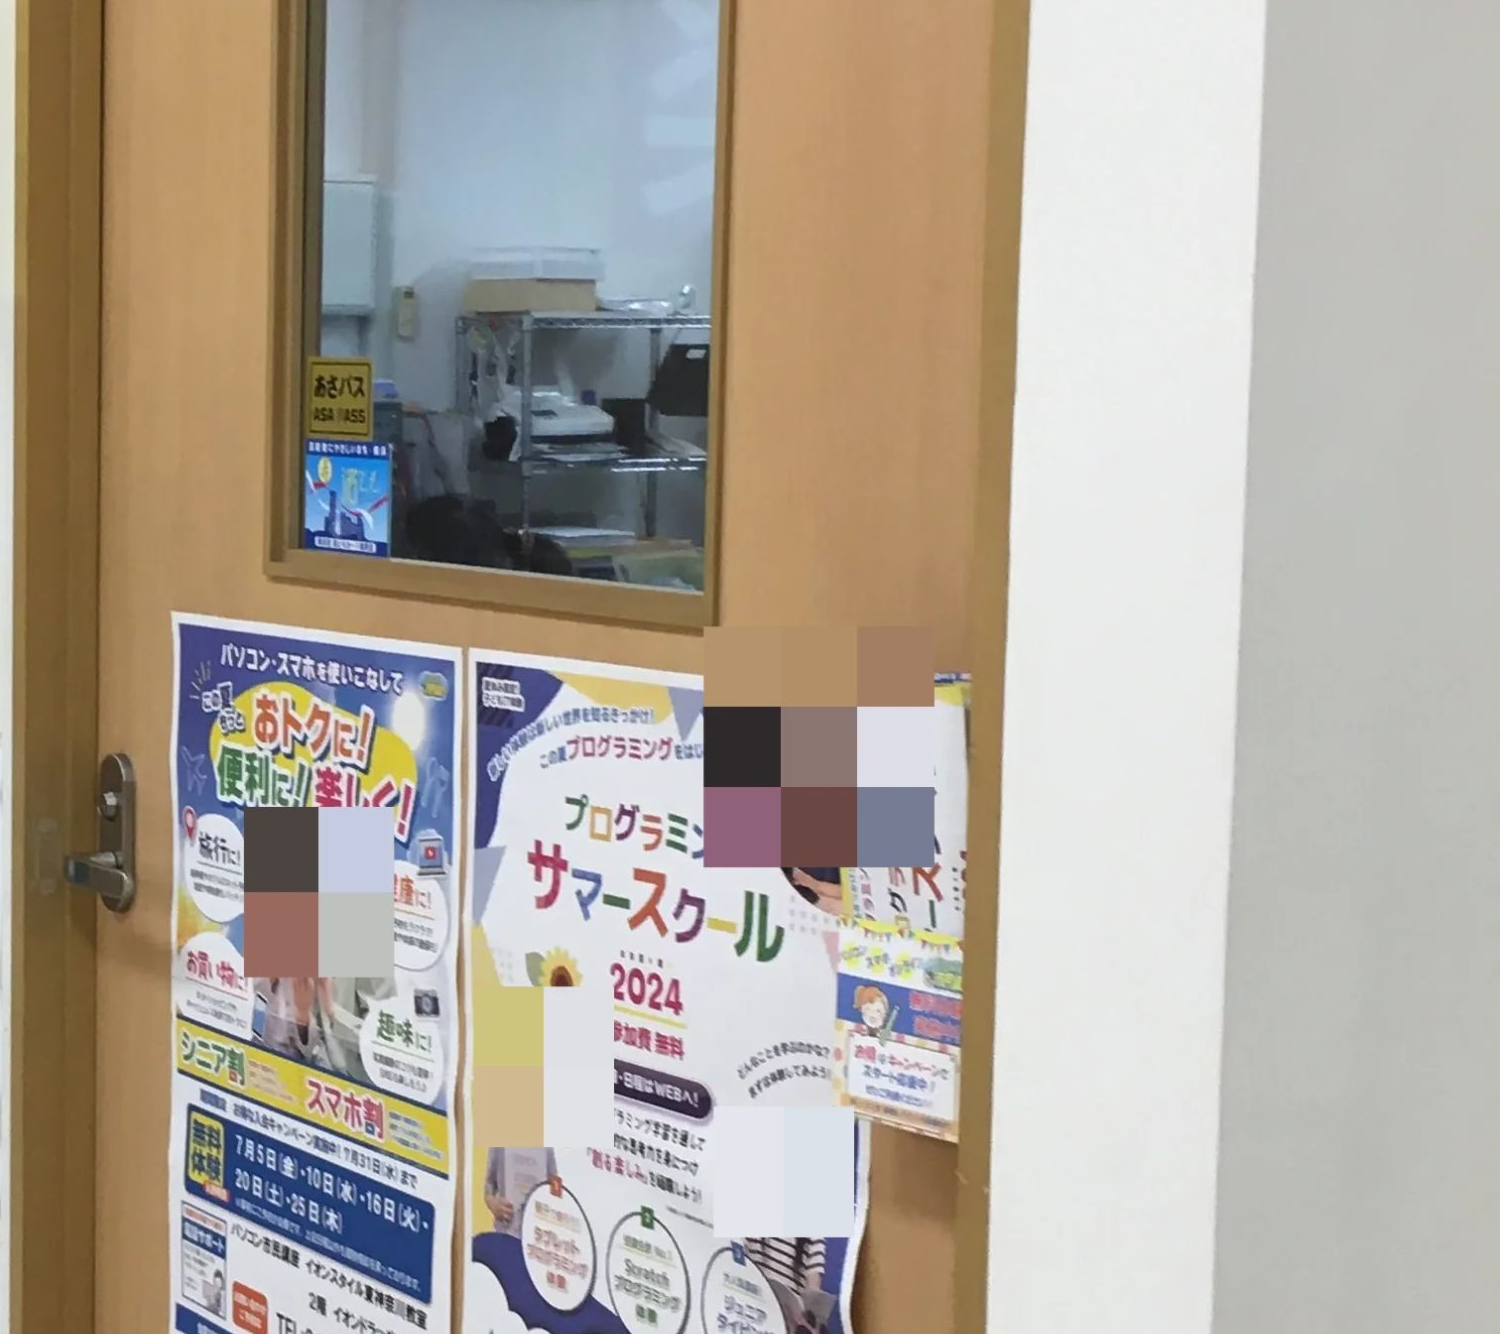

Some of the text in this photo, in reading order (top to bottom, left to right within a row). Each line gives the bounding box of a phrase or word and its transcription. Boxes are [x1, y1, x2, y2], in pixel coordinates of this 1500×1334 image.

[254, 692, 373, 763] おトクに!
[527, 839, 786, 963] サマースクール
[609, 962, 685, 1017] 2024
[180, 1029, 246, 1087] シニア割
[306, 1078, 386, 1140] スマホ割
